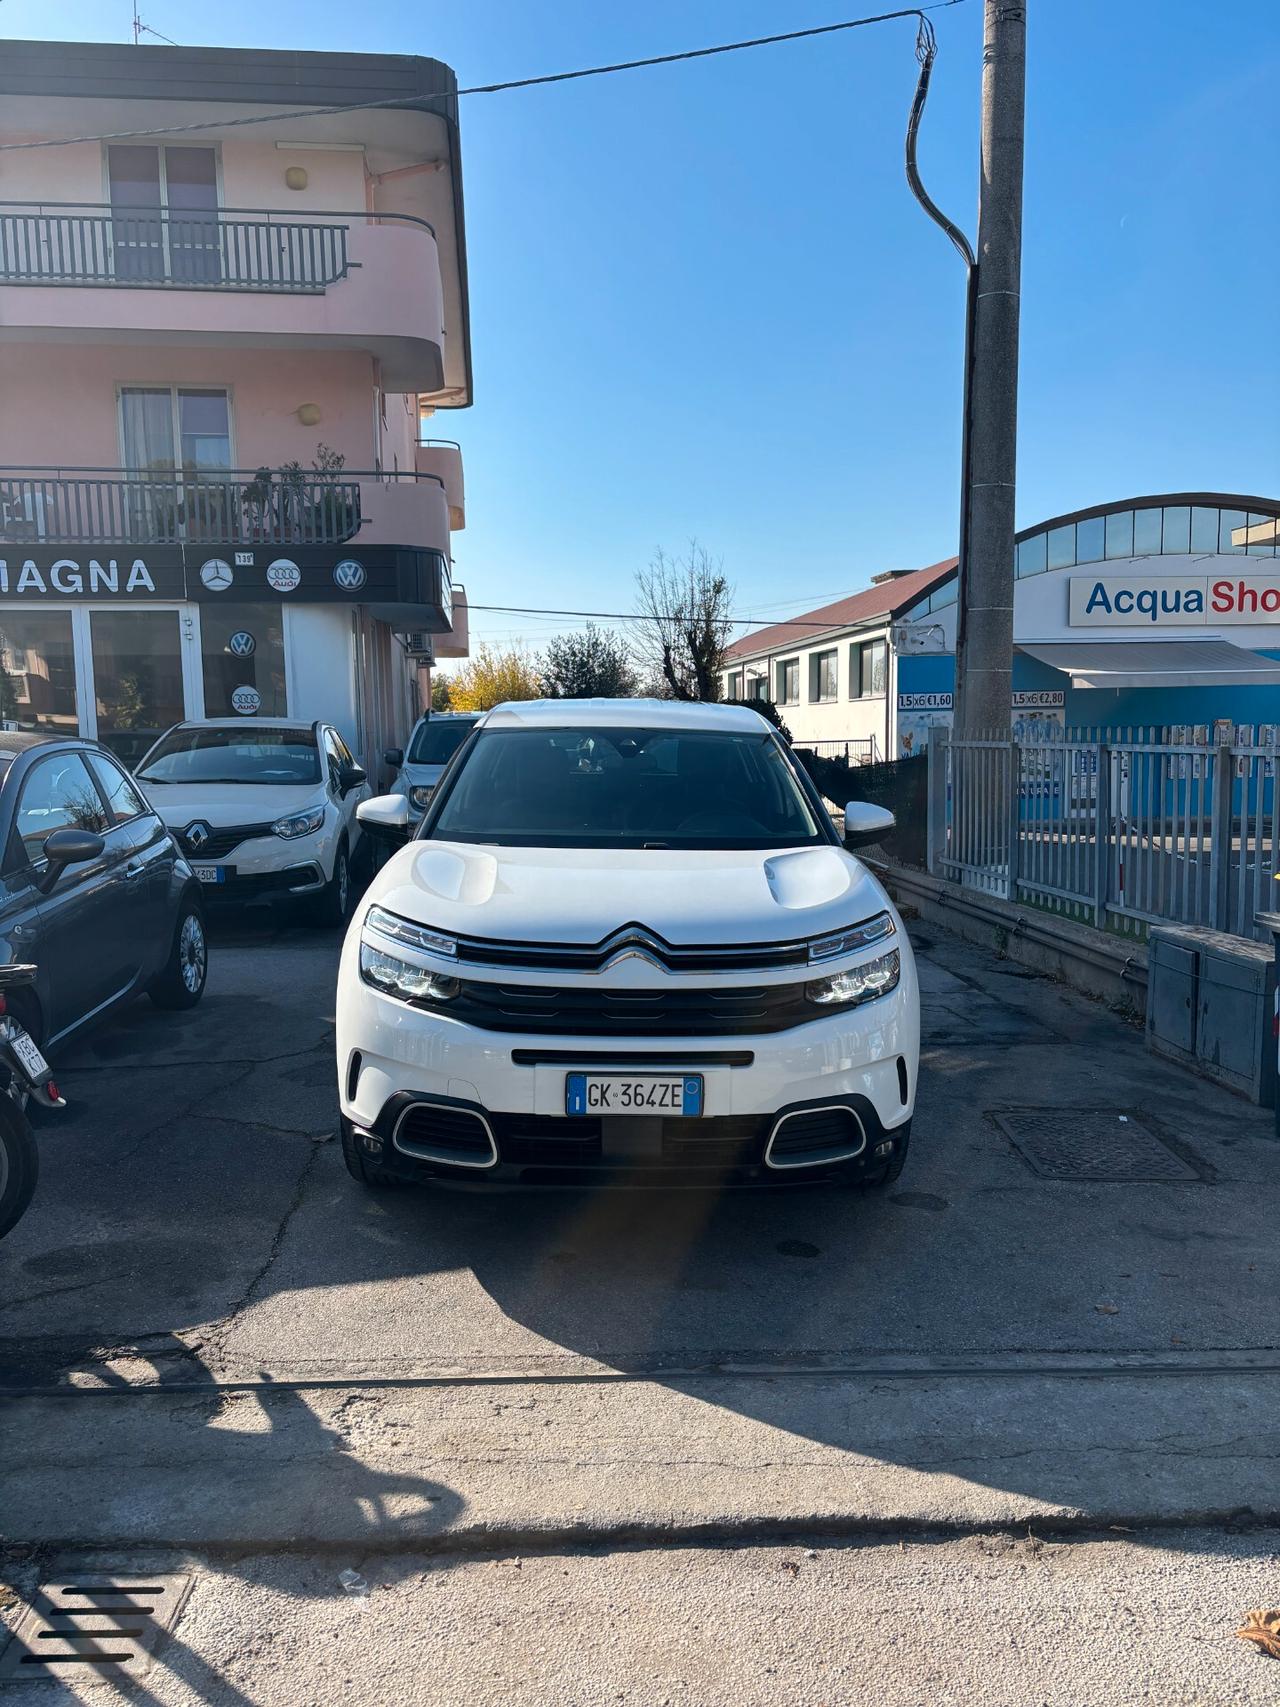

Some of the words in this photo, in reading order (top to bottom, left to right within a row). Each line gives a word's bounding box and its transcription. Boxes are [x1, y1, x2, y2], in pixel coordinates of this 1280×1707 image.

[0, 560, 155, 592] AGNA
[1085, 582, 1204, 621] Acqua
[928, 694, 951, 707] €1,60
[1040, 692, 1063, 704] €2,80
[588, 1084, 611, 1107] GK
[621, 1084, 682, 1107] 364ZE
